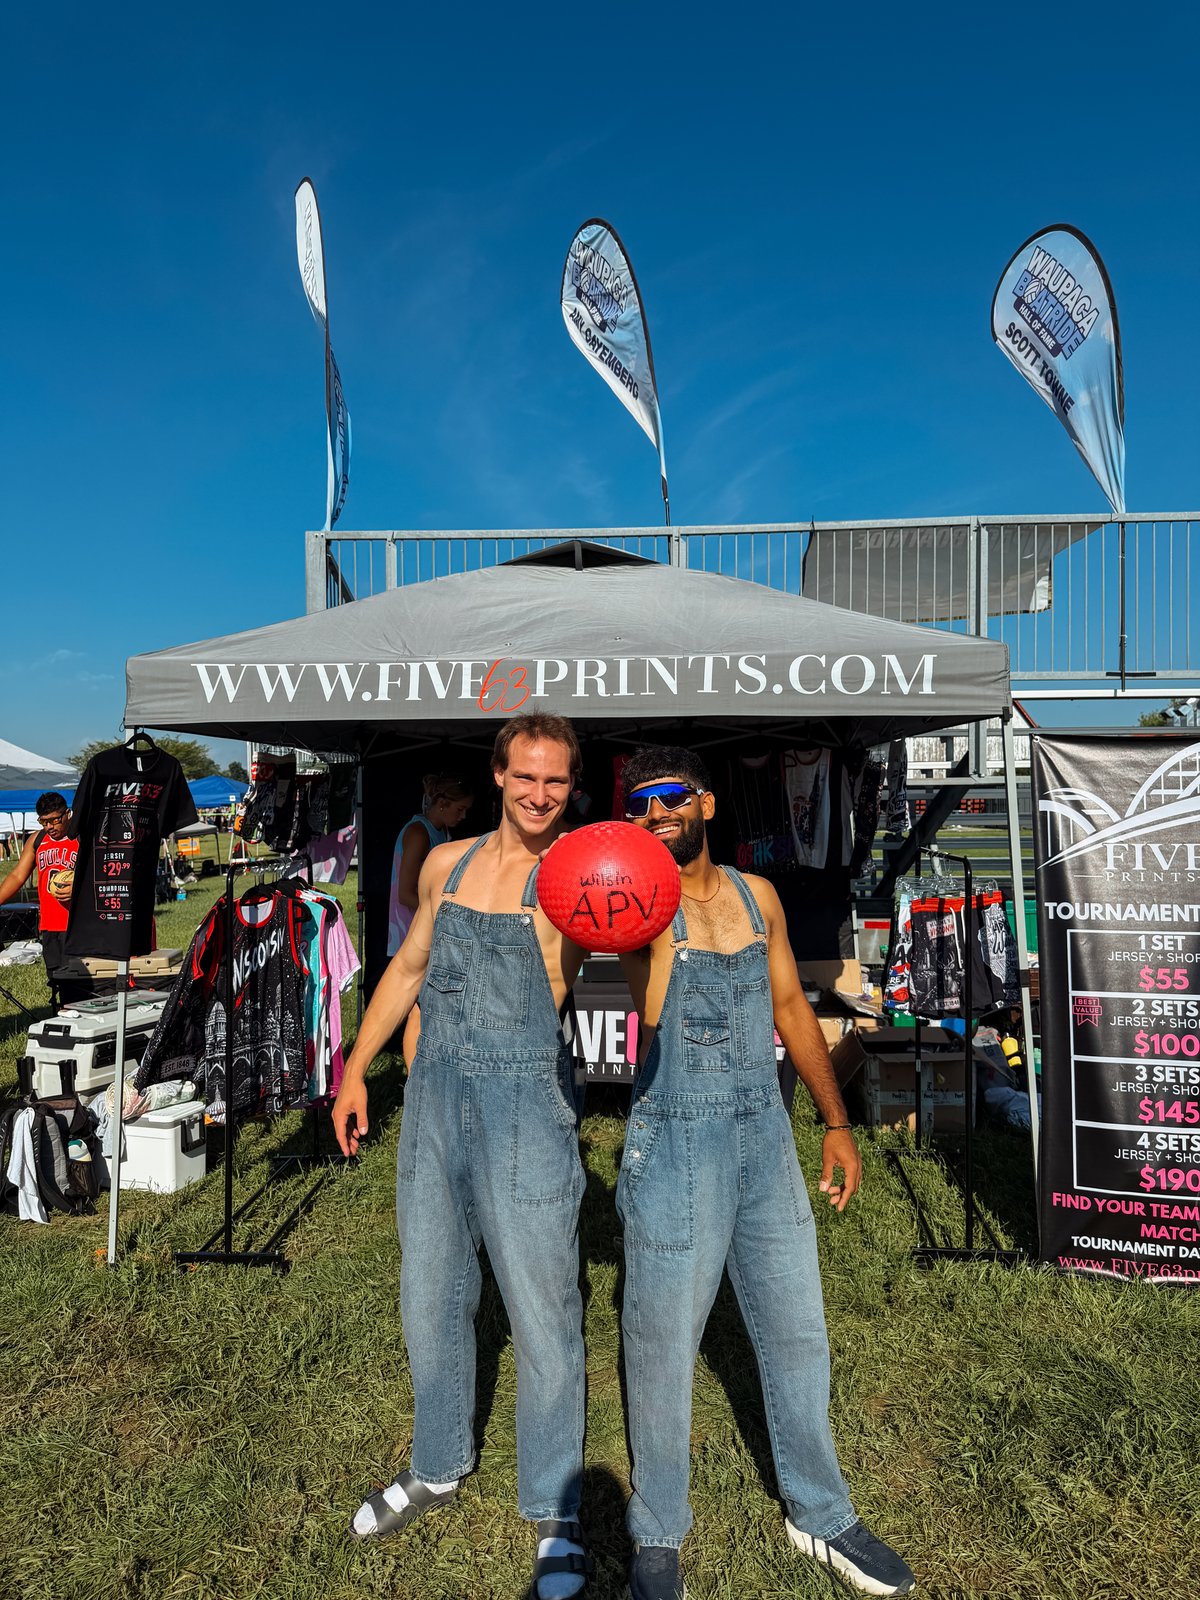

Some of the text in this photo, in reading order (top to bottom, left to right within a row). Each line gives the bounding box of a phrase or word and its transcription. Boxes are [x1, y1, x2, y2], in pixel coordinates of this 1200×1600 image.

[1027, 245, 1100, 339] WAUPACA
[1019, 303, 1056, 350] HALL OF FAME
[1005, 322, 1075, 415] SCOTT TOWNE
[38, 848, 78, 871] BULLS
[1105, 871, 1195, 882] PRINTS
[105, 898, 121, 910] $55
[569, 883, 658, 930] APV
[1045, 902, 1200, 923] TOURNAMENT
[1138, 935, 1186, 951] 1 SET
[1108, 951, 1154, 962] JERSEY
[1138, 964, 1190, 992] $55
[1132, 999, 1199, 1017] 2 SETS
[1110, 1015, 1156, 1028] JERSEY
[1169, 1017, 1200, 1030] SHO
[1133, 1030, 1200, 1057] $100
[587, 1063, 637, 1075] RINT
[1135, 1065, 1200, 1084] 3 SETS
[1112, 1082, 1159, 1094] JERSEY
[1162, 1085, 1169, 1093] +
[1138, 1096, 1200, 1124] $145
[1136, 1132, 1200, 1151] 4 SETS
[1114, 1148, 1162, 1162] JERSEY
[1165, 1153, 1173, 1161] +
[1139, 1163, 1200, 1193] $190
[1052, 1192, 1200, 1221] FIND YOUR TEAM
[1071, 1235, 1176, 1258] TOURNAMENT
